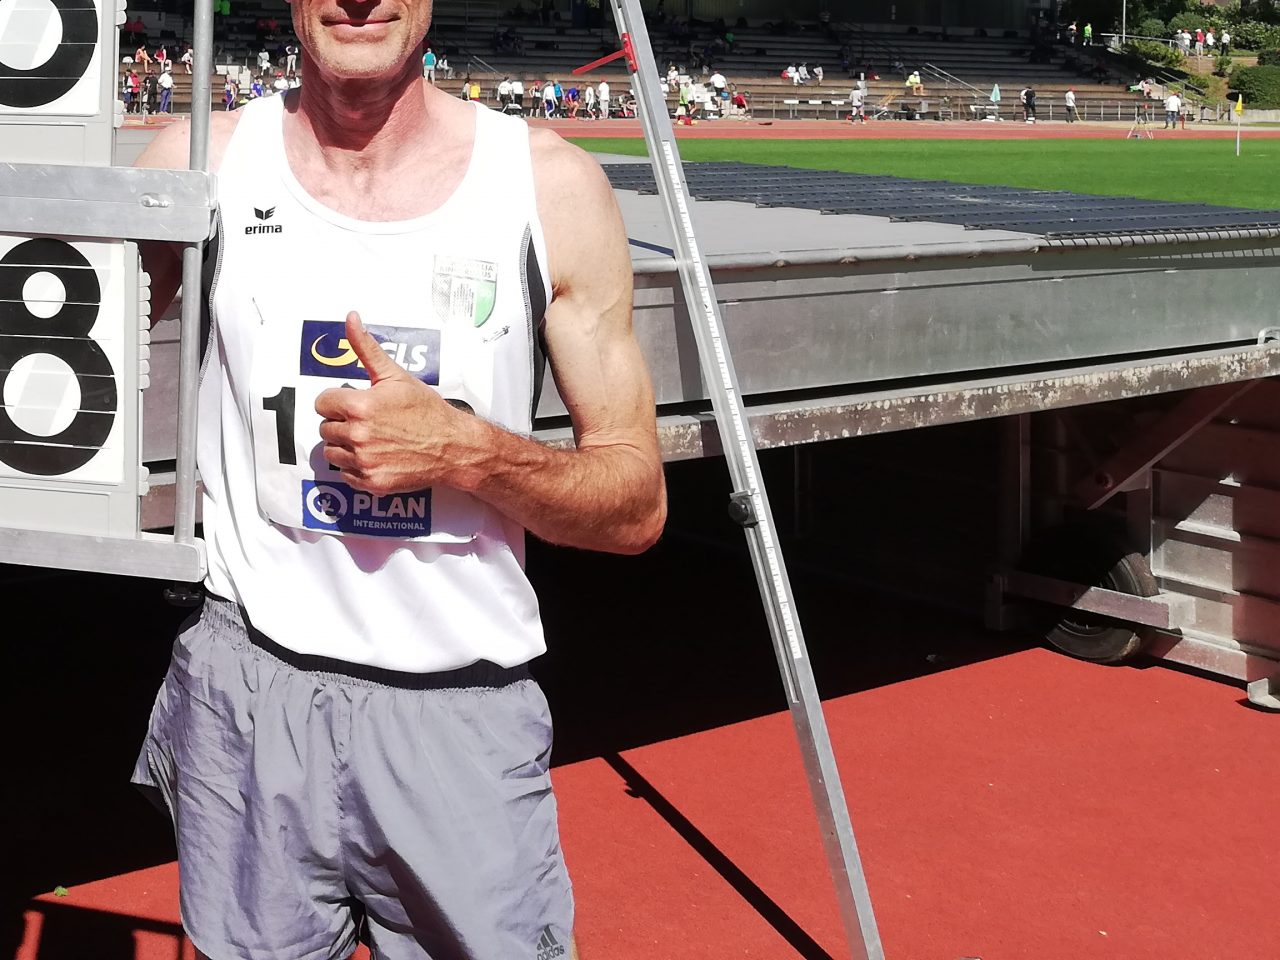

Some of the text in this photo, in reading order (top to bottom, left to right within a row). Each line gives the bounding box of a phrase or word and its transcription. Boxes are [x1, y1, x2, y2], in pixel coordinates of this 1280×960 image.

[245, 223, 283, 235] erima
[353, 493, 426, 518] PLAN
[353, 519, 425, 530] INTERNATIONAL
